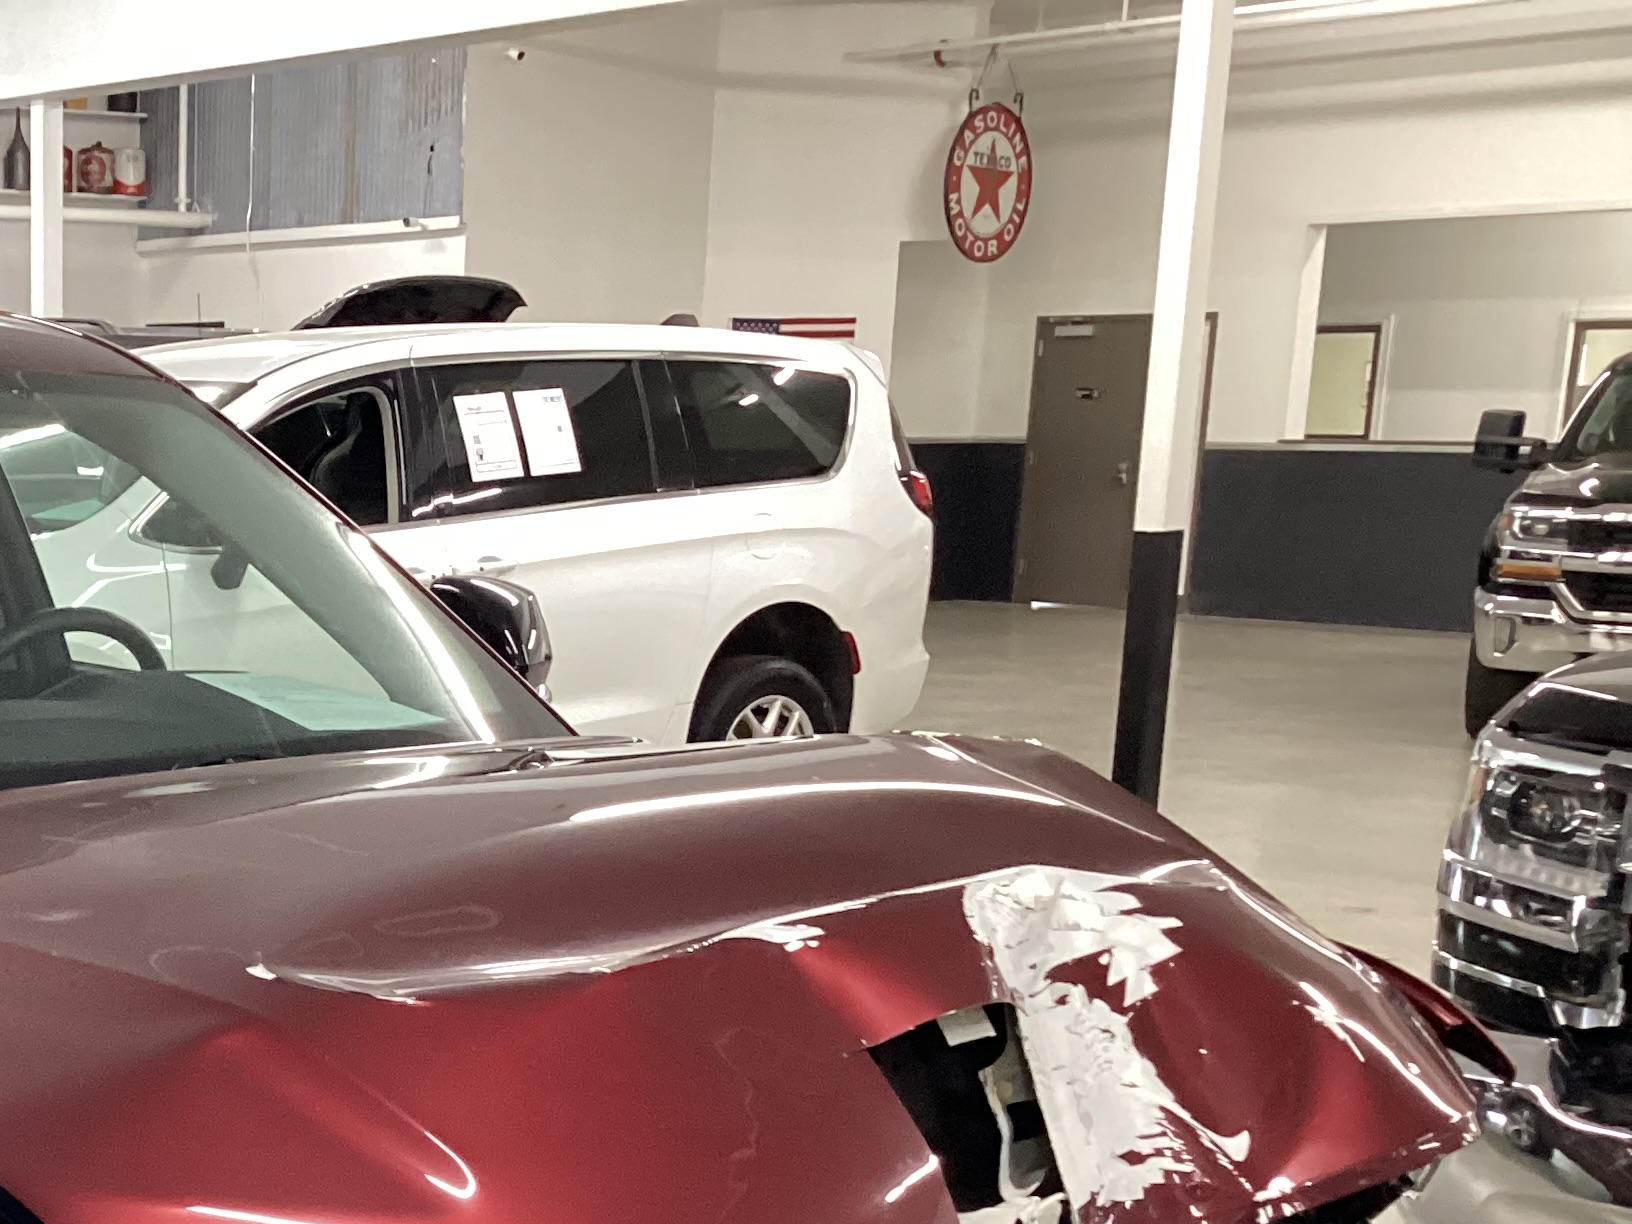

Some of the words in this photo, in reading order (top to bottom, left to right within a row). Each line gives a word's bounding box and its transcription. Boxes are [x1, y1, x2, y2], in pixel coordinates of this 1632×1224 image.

[953, 110, 1028, 173] GASOLINE
[948, 192, 998, 257] MOTOR
[1003, 198, 1026, 241] OIL
